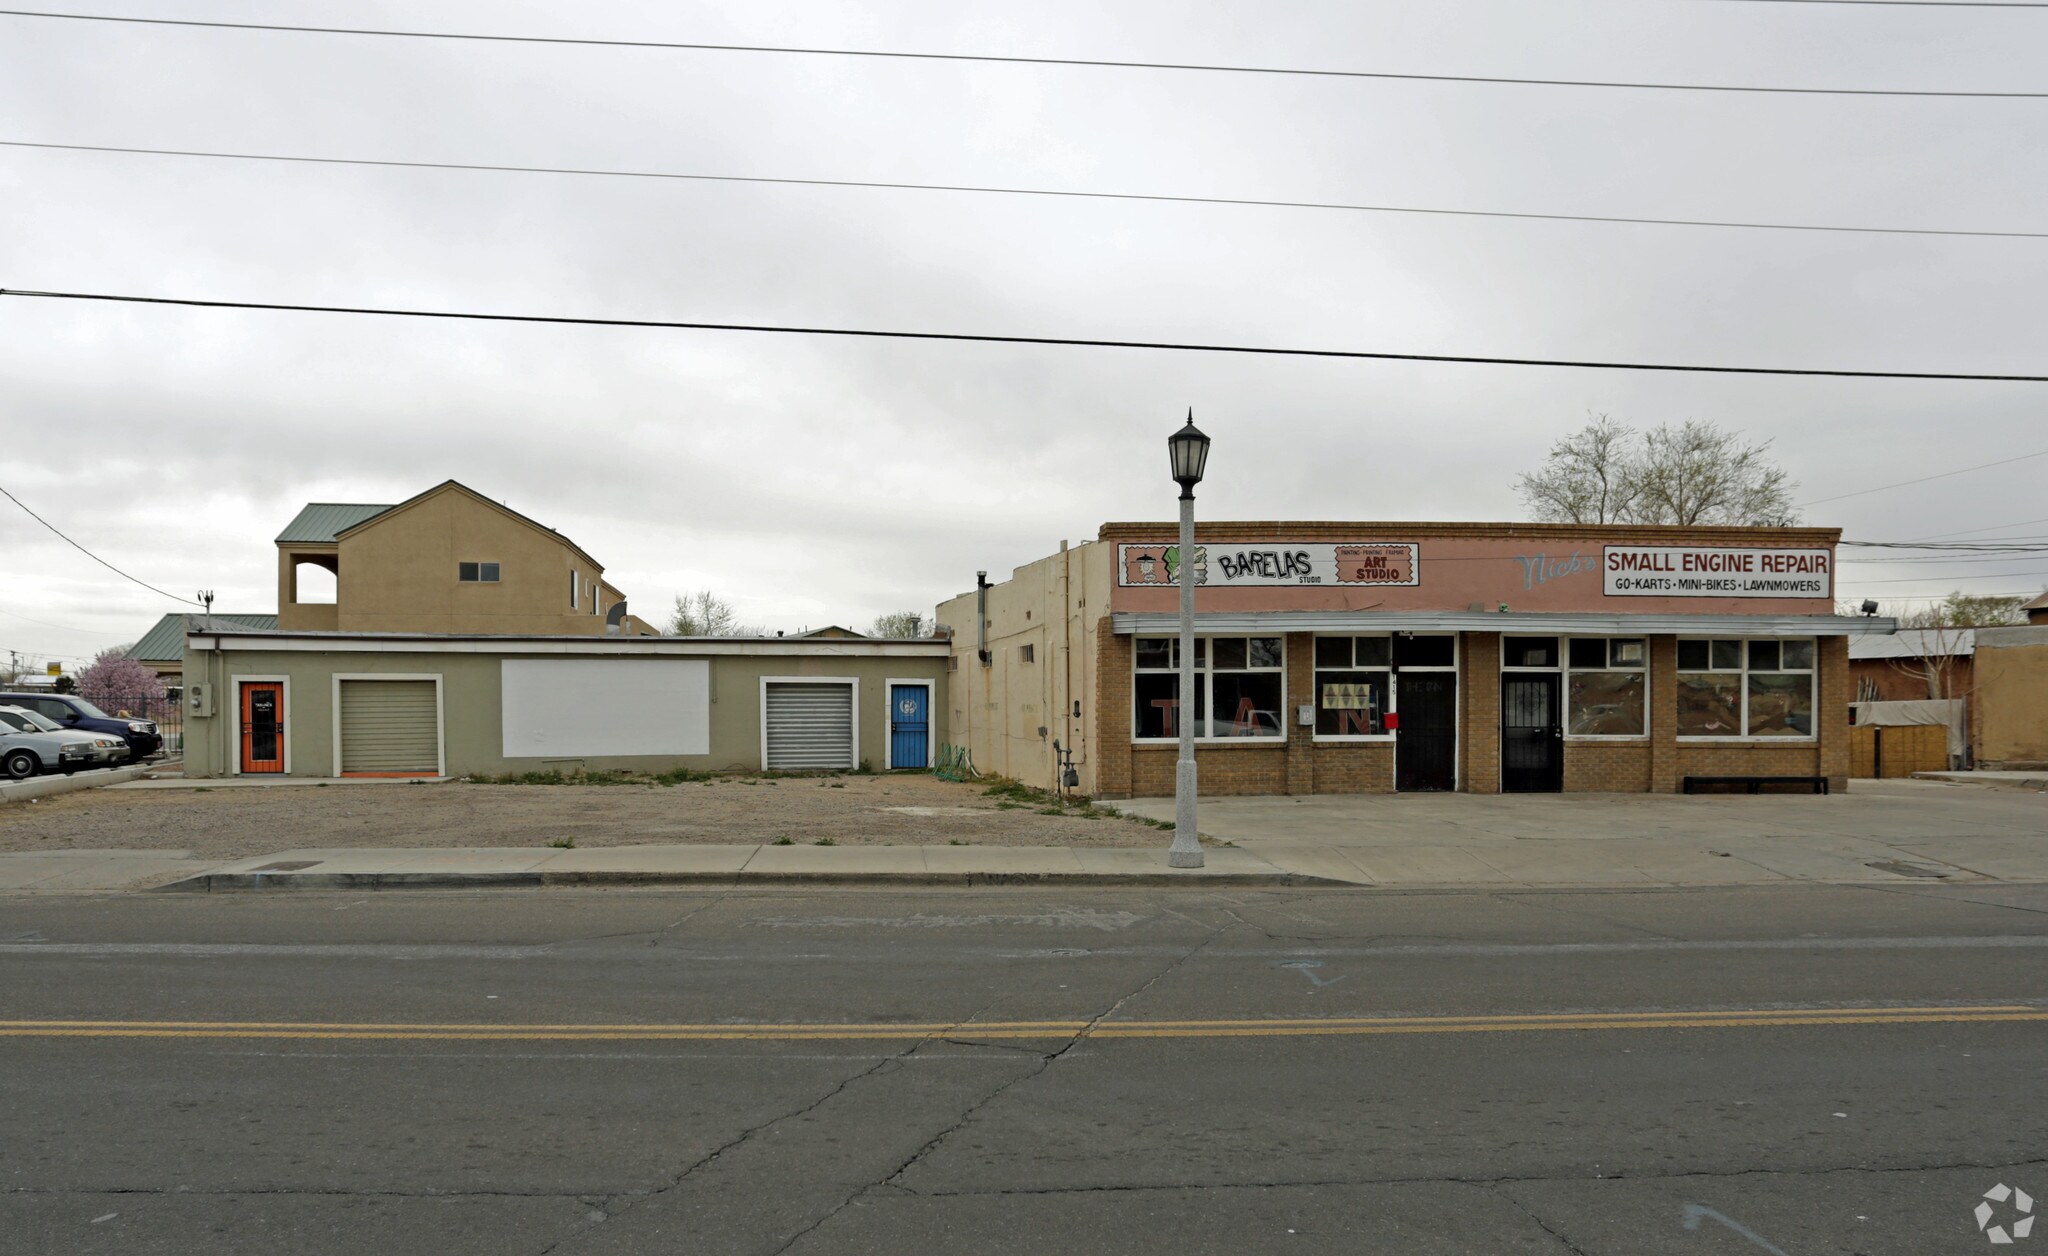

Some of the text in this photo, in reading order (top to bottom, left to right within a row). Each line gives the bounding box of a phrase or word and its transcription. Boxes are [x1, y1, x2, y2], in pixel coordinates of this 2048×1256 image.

[1218, 550, 1312, 580] BARELAS
[1364, 556, 1387, 568] ART
[1608, 552, 1828, 574] SMALL ENGINE REPAIR
[1356, 568, 1399, 580] STUDIO
[1615, 578, 1821, 592] GO-KARTS MINI-BIKES LAWNMOWERS
